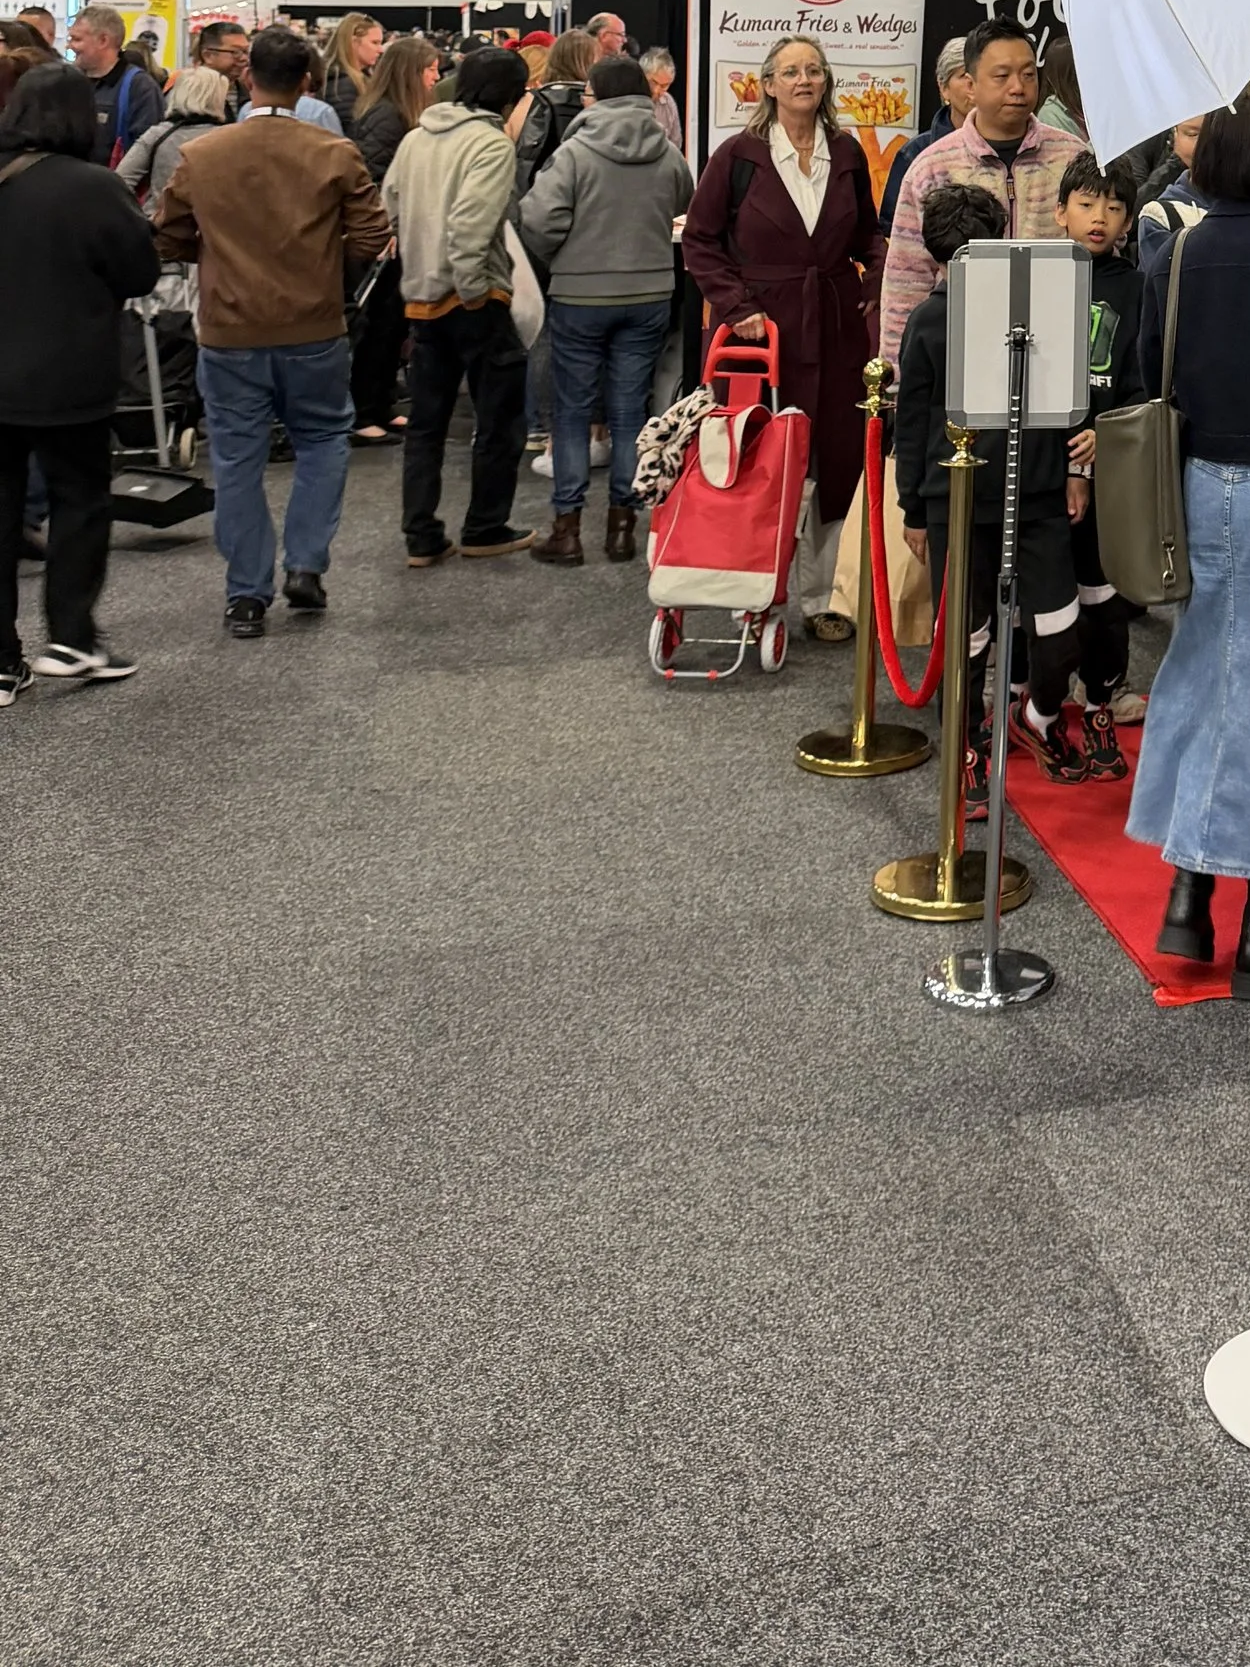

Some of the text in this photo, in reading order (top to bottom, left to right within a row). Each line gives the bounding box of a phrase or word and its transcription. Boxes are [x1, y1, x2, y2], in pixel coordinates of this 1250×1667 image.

[718, 9, 917, 42] Kumara Fries & Wedges
